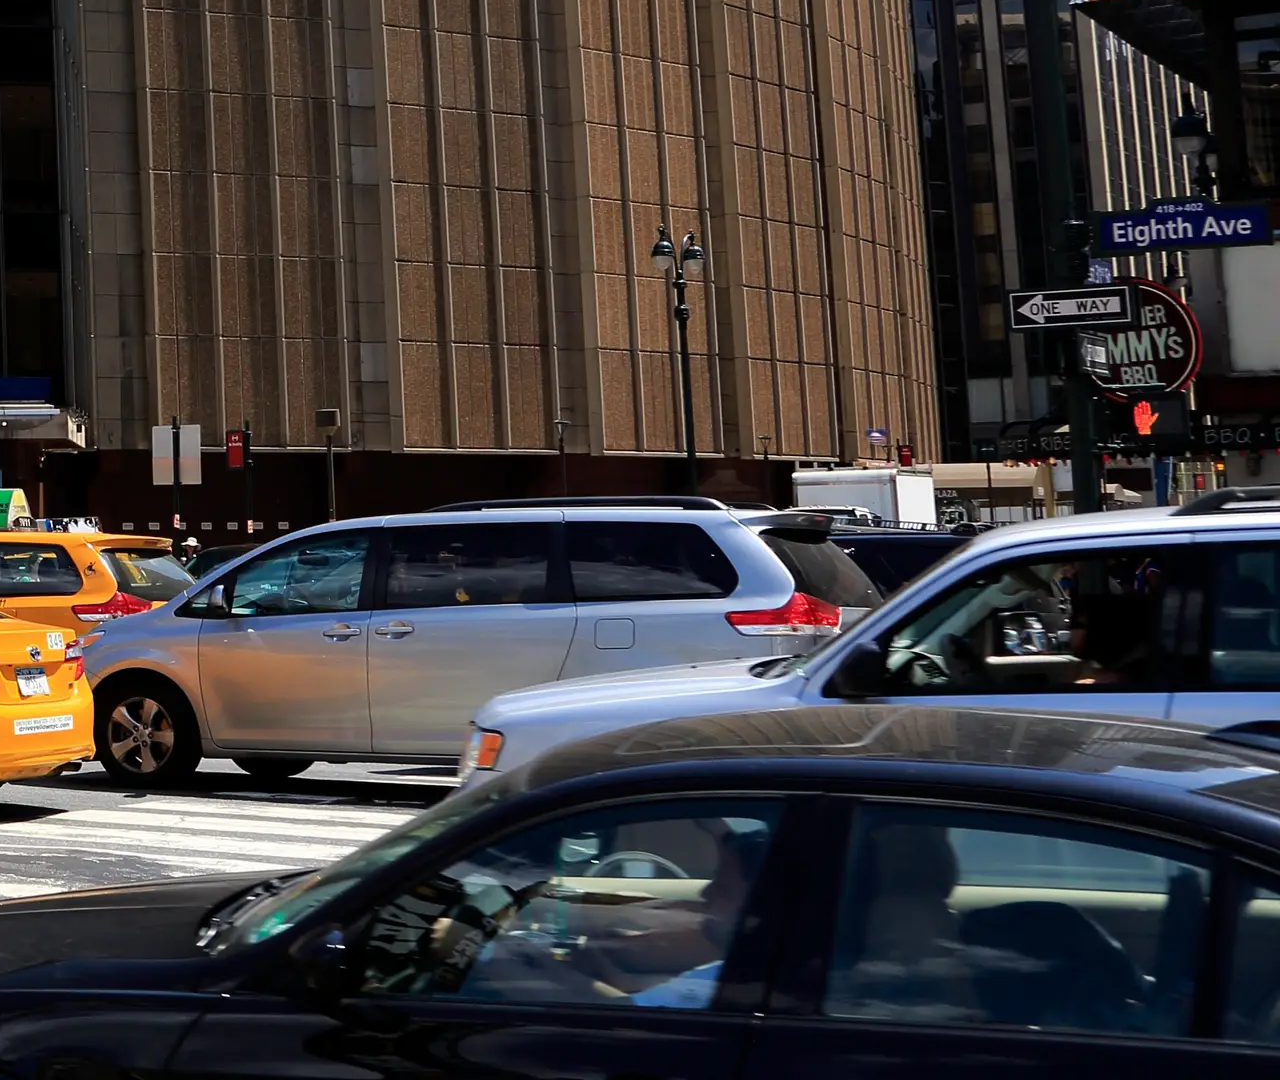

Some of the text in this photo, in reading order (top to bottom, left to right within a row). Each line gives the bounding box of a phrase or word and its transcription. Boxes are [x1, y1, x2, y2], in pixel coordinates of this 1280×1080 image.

[1113, 216, 1252, 247] Eighth Ave
[1030, 295, 1111, 316] ONE WAY
[1107, 325, 1185, 365] MMY'S
[1120, 363, 1159, 385] BBQ
[1204, 429, 1252, 444] BBQ
[48, 634, 63, 649] 349
